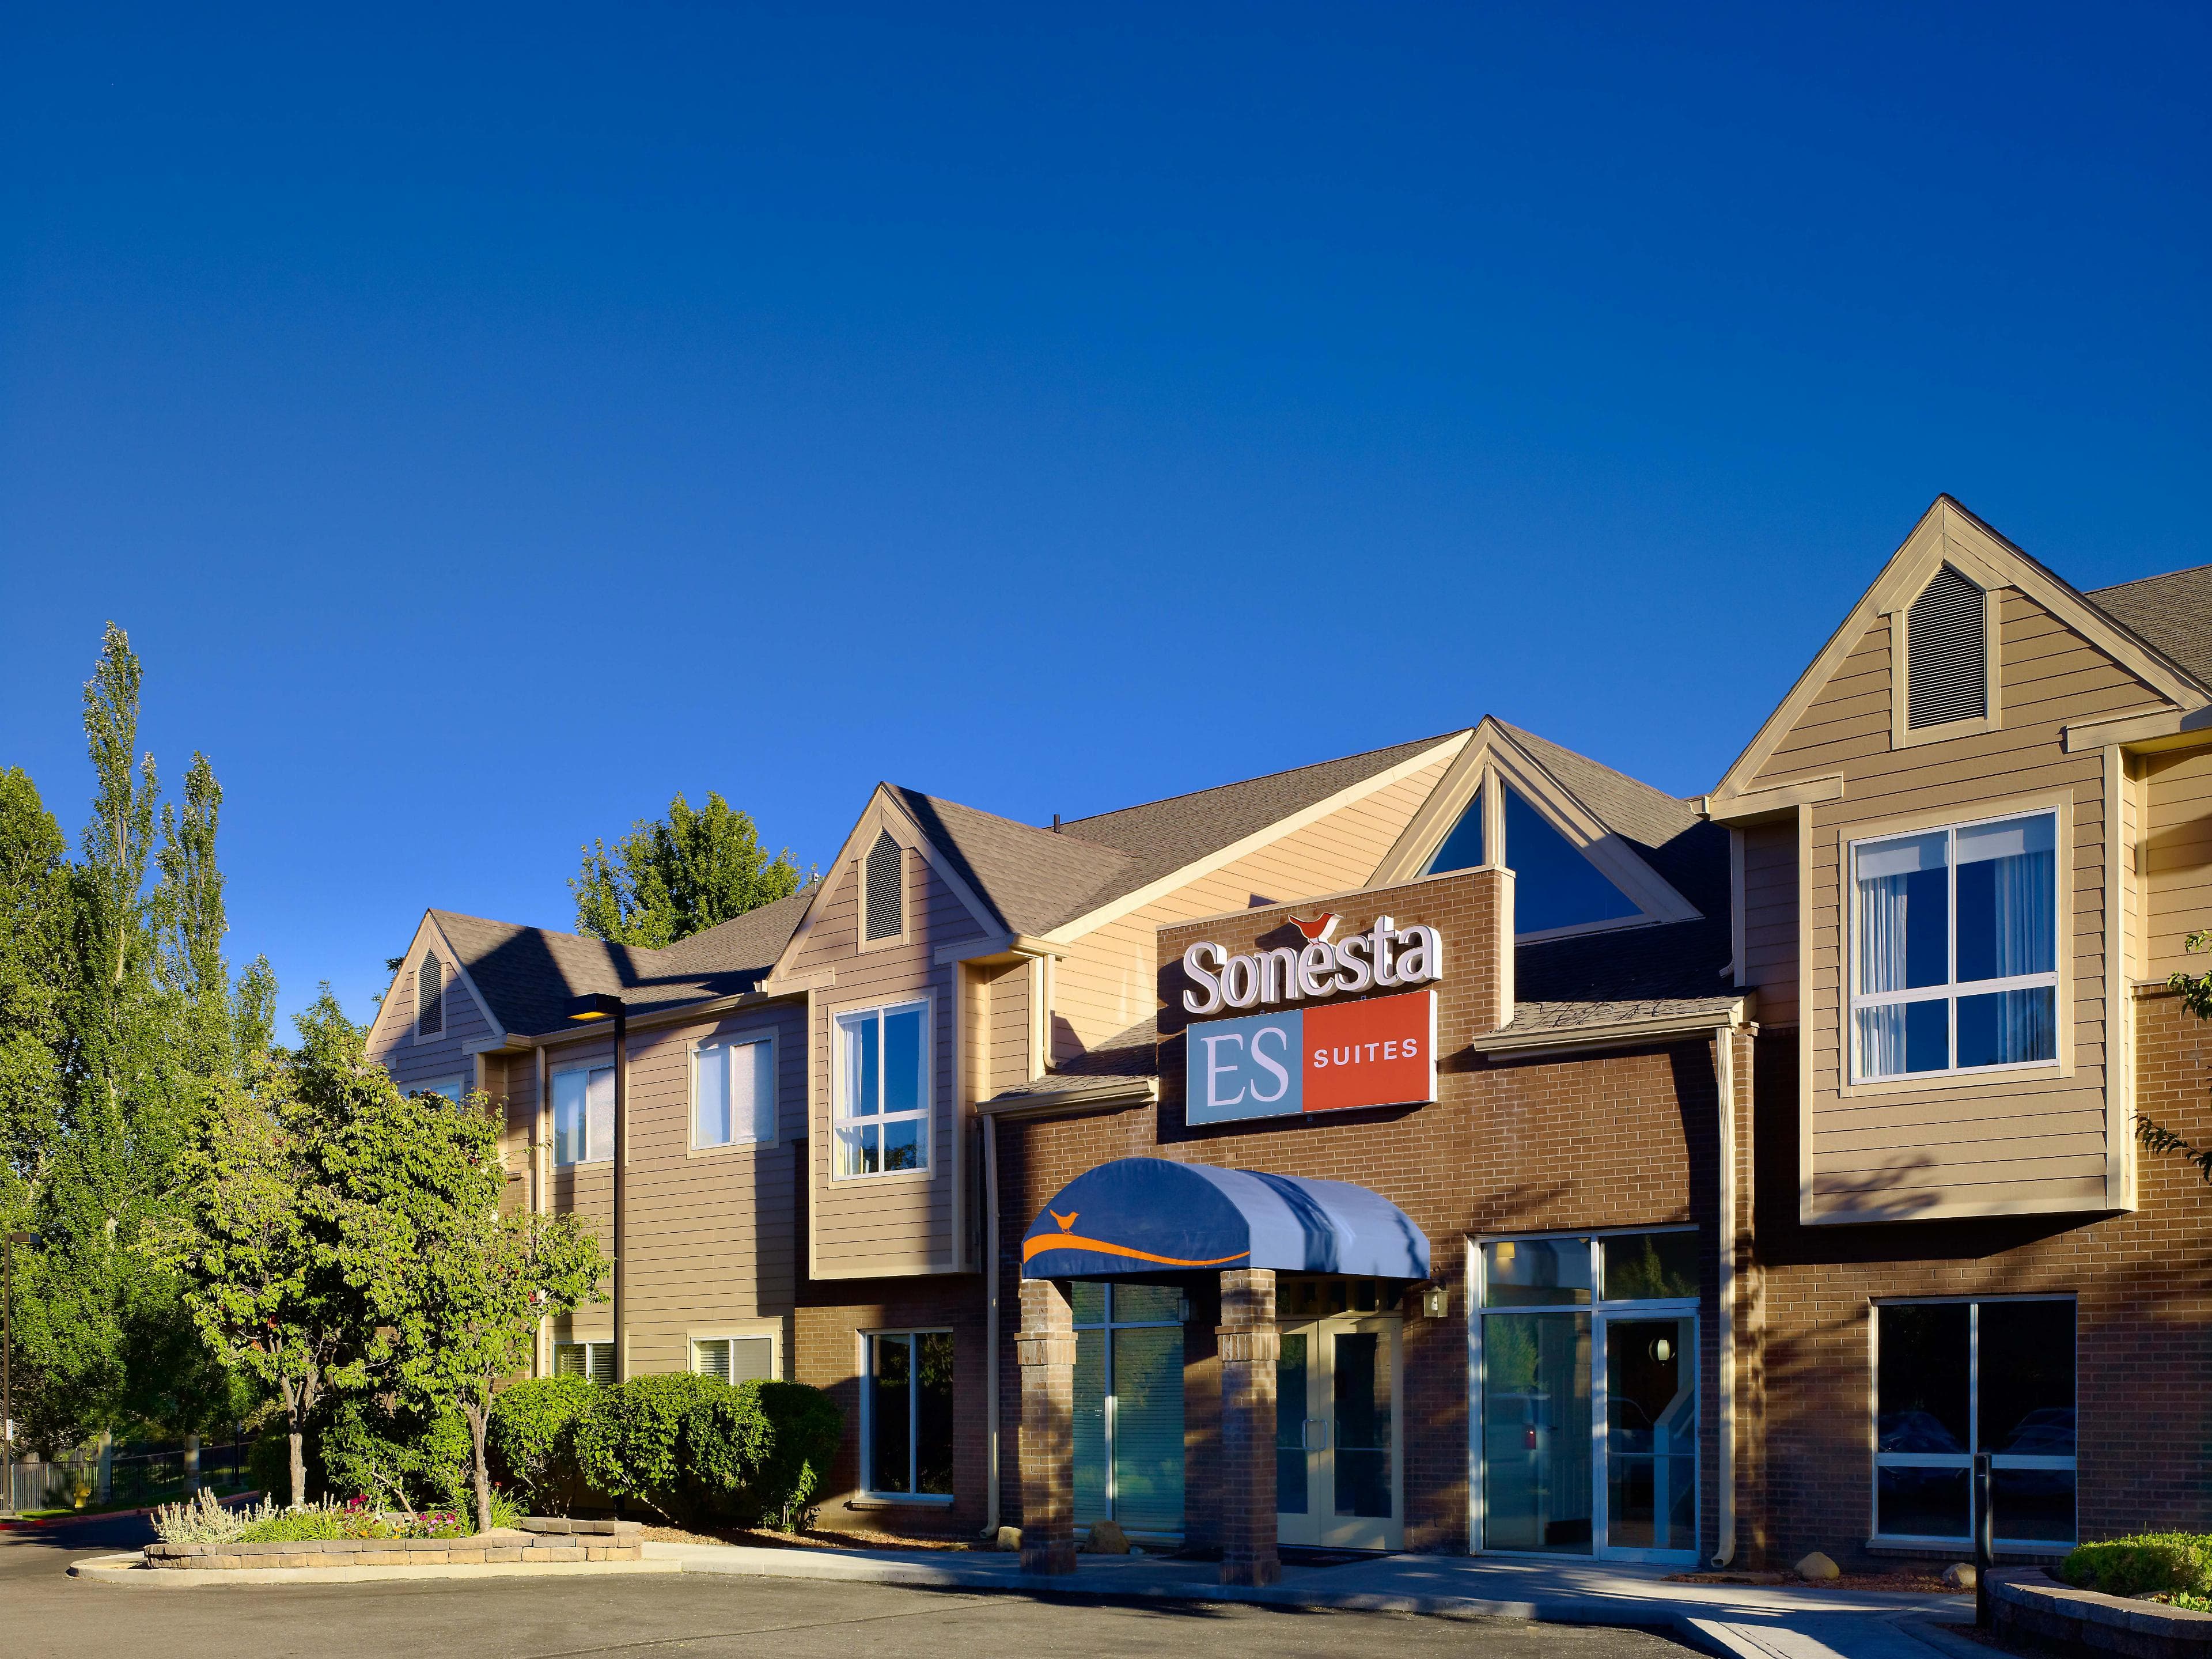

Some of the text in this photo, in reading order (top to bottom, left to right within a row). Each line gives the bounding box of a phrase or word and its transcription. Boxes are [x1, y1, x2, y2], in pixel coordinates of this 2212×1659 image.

[1183, 915, 1442, 1014] Sonesta
[1200, 1027, 1418, 1107] ES SUITES
